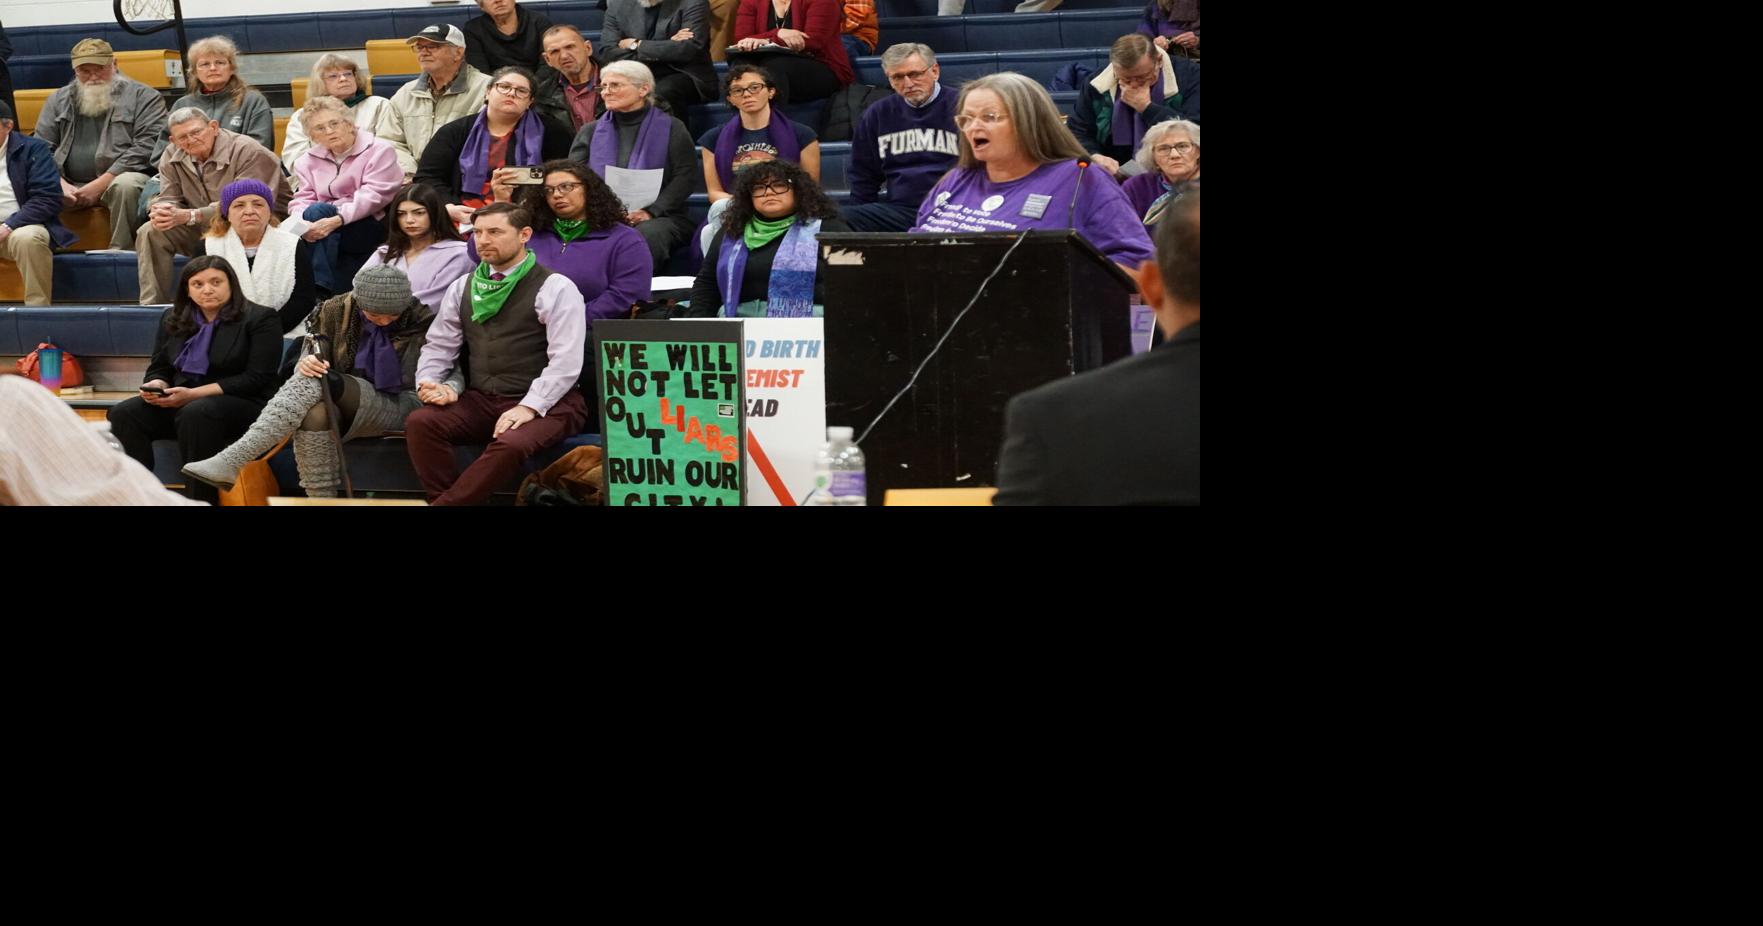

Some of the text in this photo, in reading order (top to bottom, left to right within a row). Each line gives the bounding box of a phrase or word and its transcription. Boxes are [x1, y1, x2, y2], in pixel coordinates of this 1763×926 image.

[878, 128, 960, 159] FURMAN
[604, 343, 733, 371] WE WILL
[760, 340, 821, 358] BIRTH
[606, 370, 737, 400] NOT LET
[606, 396, 665, 455] OUT
[660, 397, 739, 462] LIARS
[609, 457, 739, 490] RUIN OUR
